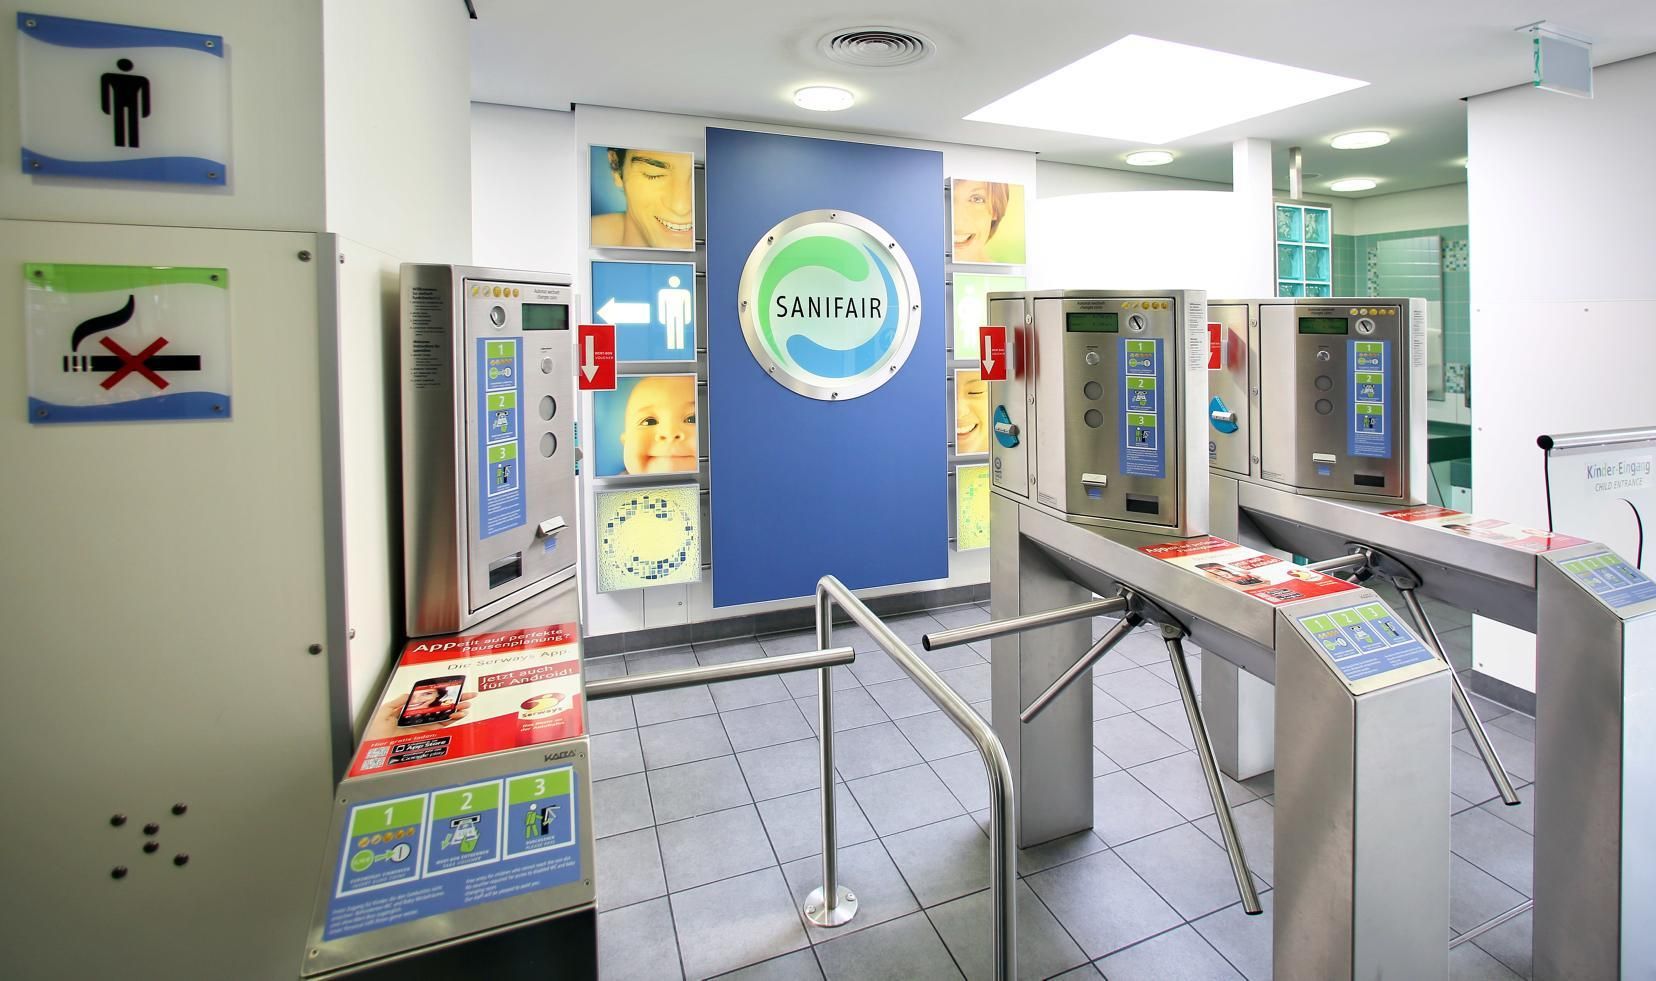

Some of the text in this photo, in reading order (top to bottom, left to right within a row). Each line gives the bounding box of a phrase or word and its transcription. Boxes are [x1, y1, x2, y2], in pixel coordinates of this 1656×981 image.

[776, 295, 882, 319] SANIFAIR
[1138, 379, 1144, 388] 2
[499, 396, 505, 407] 2
[1138, 416, 1144, 425] 3
[500, 447, 506, 459] 3
[1587, 461, 1651, 480] Kinder-Eingang
[1595, 478, 1643, 492] CHILD ENTRANCE
[1315, 607, 1378, 629] 1 2 3
[462, 633, 571, 652] Pausenplanung?
[485, 635, 504, 645] auf
[509, 629, 564, 643] perfekte
[447, 648, 568, 671] Die Serways App
[480, 665, 553, 685] Jetzt auch
[482, 668, 574, 691] für Android!
[389, 737, 411, 746] gratis
[406, 742, 423, 751] App
[424, 740, 447, 748] Store
[533, 778, 546, 796] 3
[460, 791, 473, 810] 2
[383, 807, 394, 827] 1
